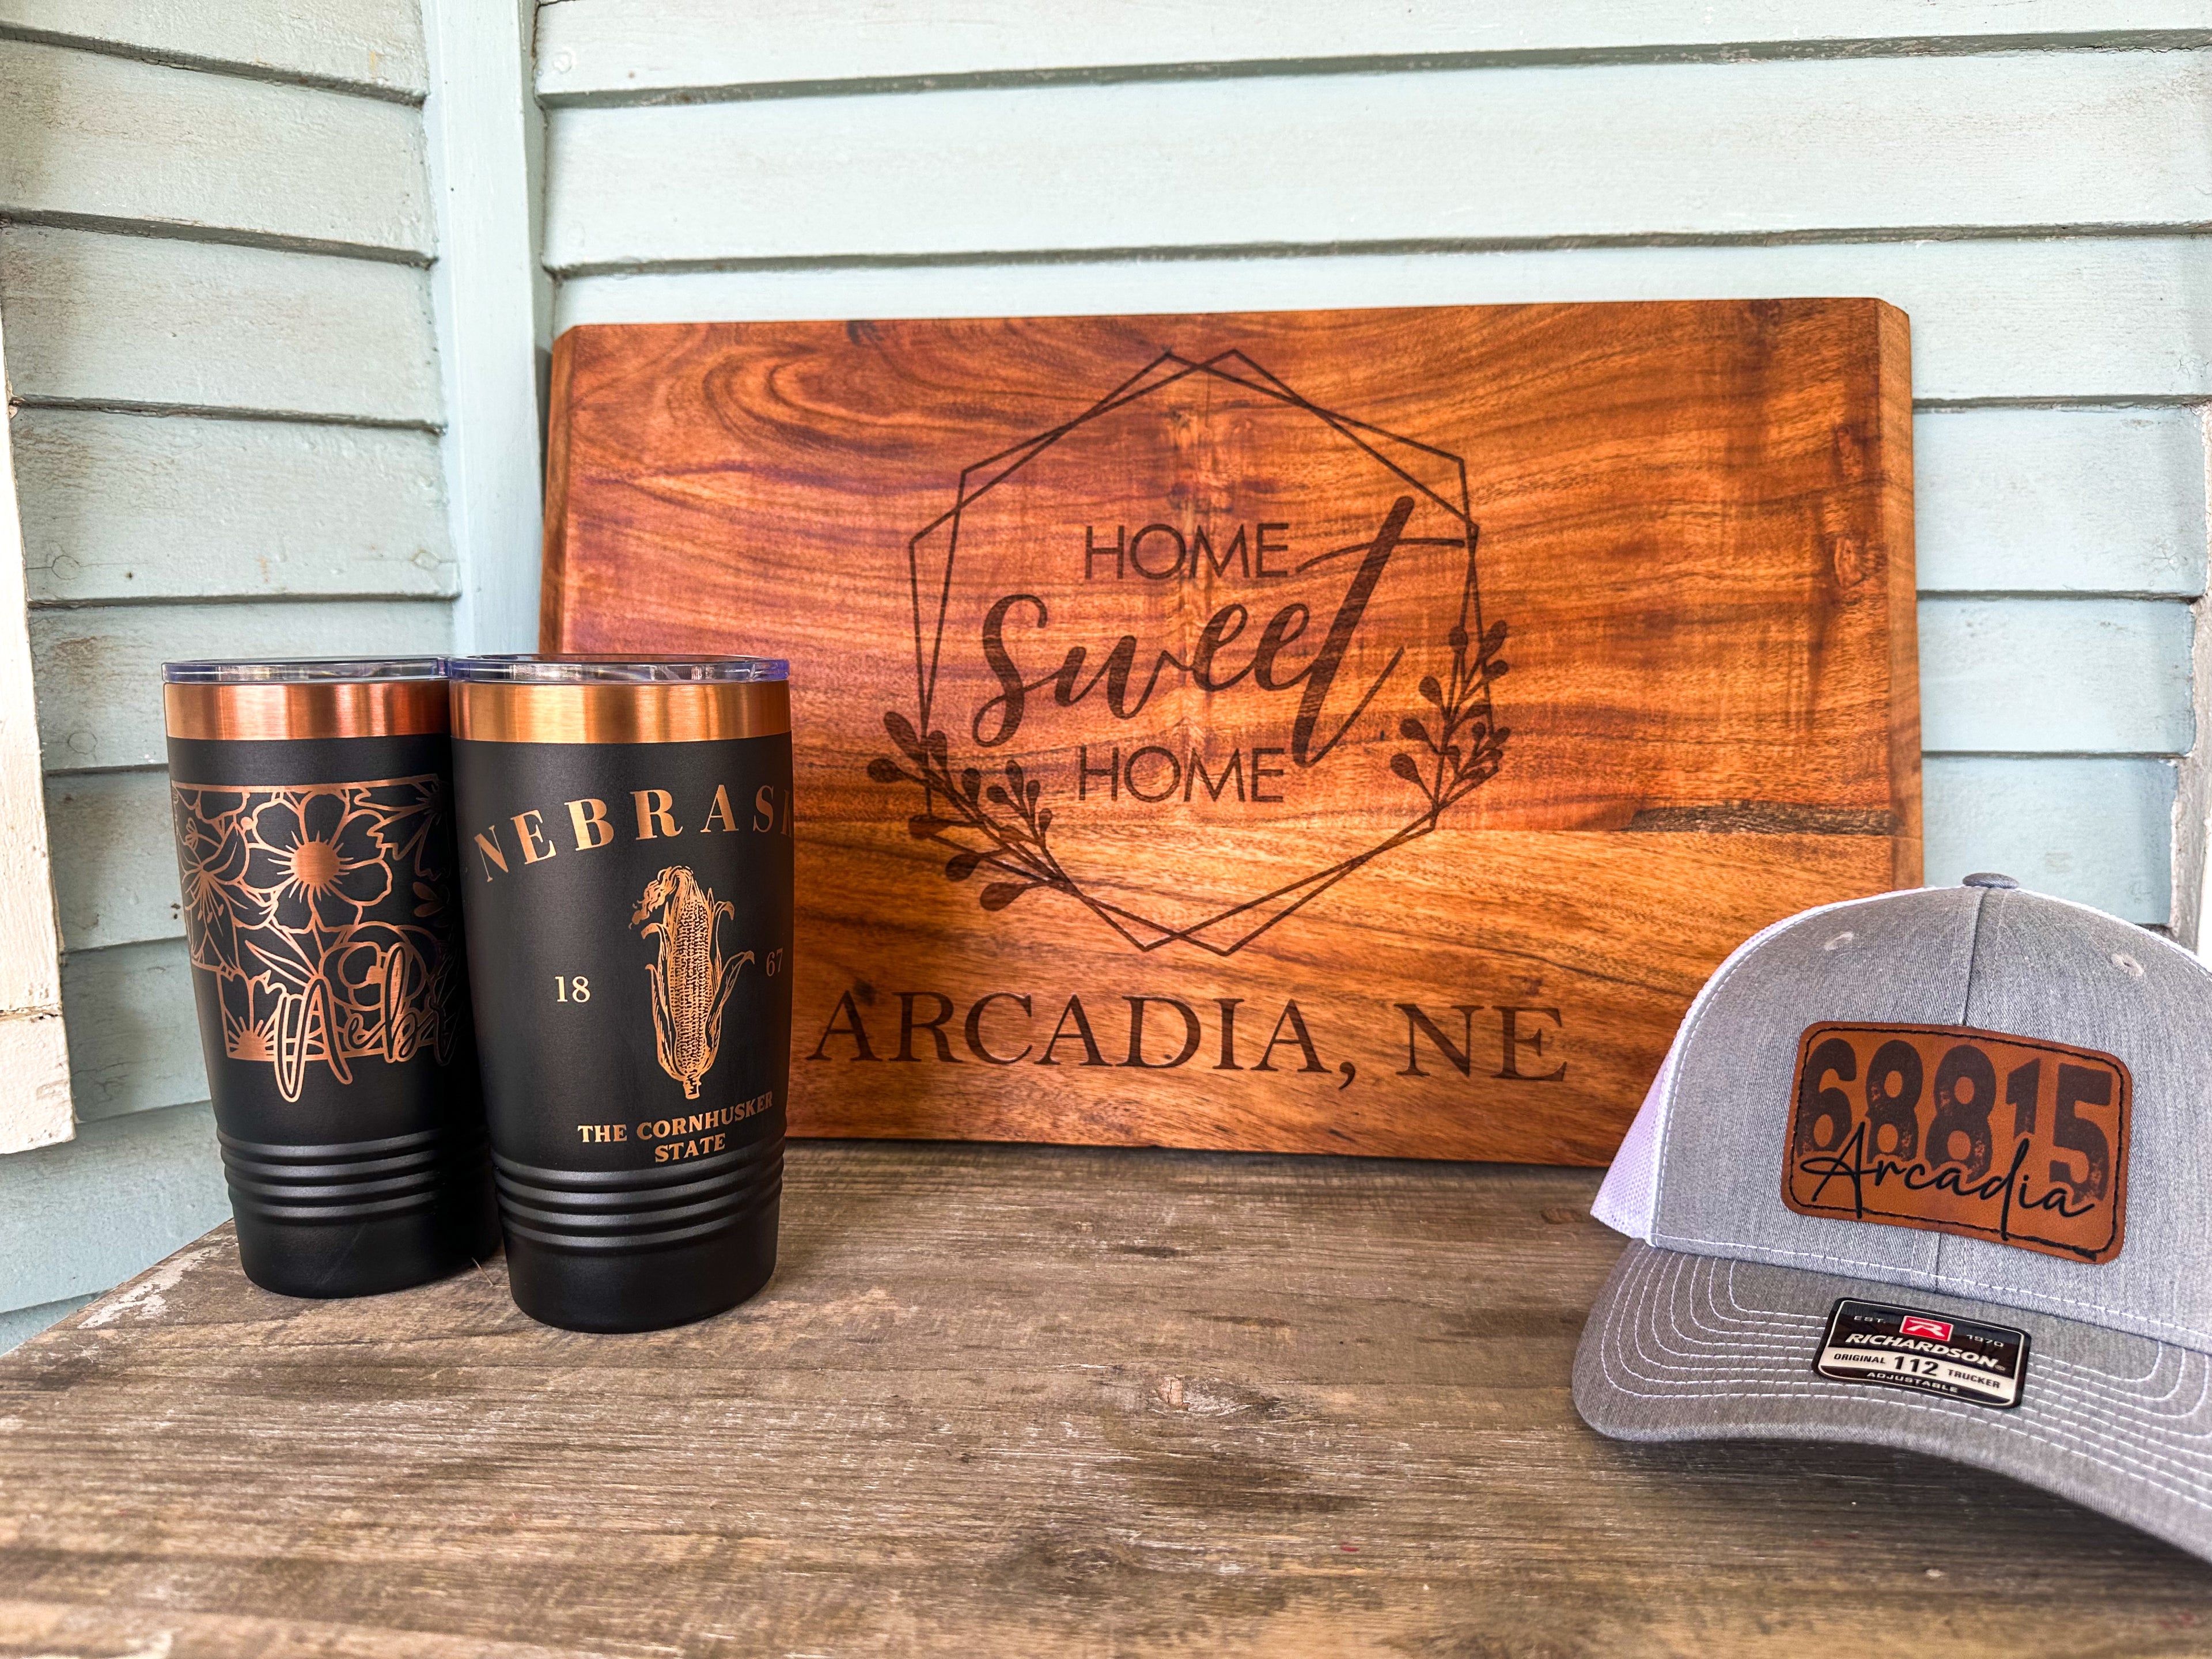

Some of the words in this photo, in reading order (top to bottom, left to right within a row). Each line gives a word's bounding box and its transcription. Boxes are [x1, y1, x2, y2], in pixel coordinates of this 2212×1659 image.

[1085, 522, 1289, 579] HOME
[972, 496, 1464, 767] Sweet
[1078, 745, 1285, 803] HOME
[555, 975, 591, 1003] 18
[766, 948, 783, 978] 67
[808, 989, 1357, 1090] ARCADIA,
[1393, 1002, 1568, 1082] NE
[578, 1124, 627, 1143] THE
[637, 1091, 774, 1140] CORNHUSKER
[1795, 1037, 2113, 1204] 68815
[655, 1135, 726, 1163] STATE
[1800, 1122, 2094, 1241] Arcadia
[1853, 1315, 1886, 1324] EST.
[1965, 1334, 2005, 1347] 1970
[1834, 1353, 1885, 1365] ORIGINAL
[1894, 1356, 1940, 1377] 112
[1948, 1368, 2001, 1389] TRUCKER
[1866, 1372, 1958, 1393] ADJUSTABLE
